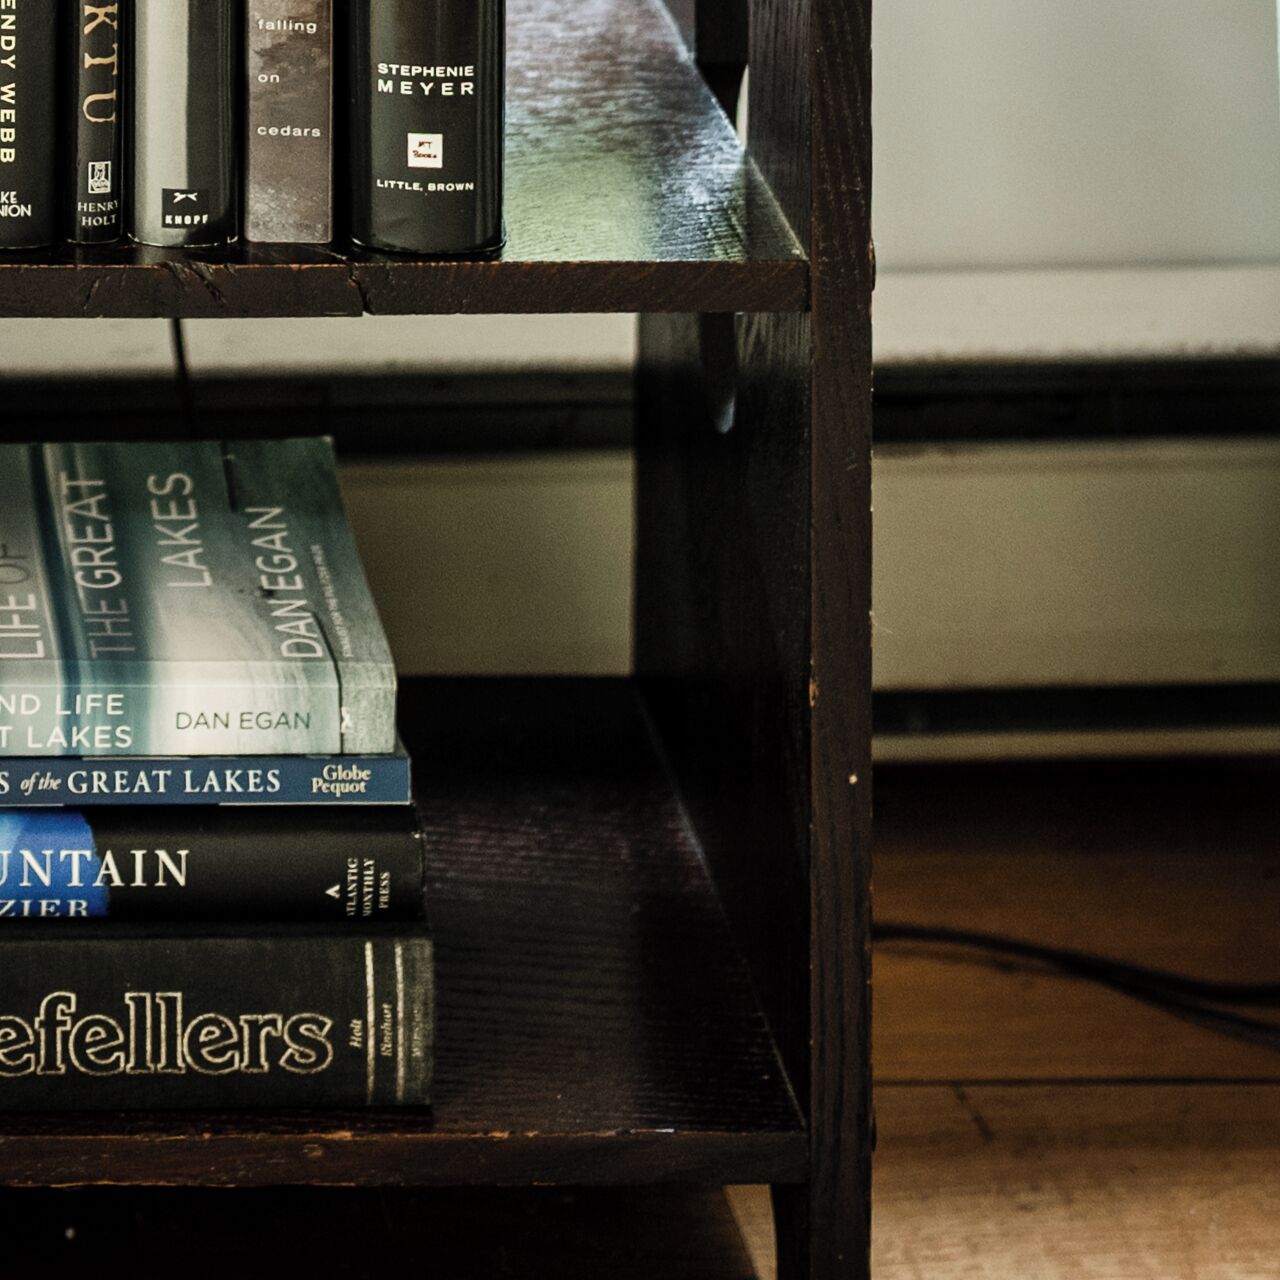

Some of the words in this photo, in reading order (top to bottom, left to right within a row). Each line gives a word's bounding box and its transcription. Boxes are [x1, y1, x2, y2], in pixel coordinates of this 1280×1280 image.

[257, 18, 318, 34] falling
[257, 72, 280, 84] on
[377, 62, 475, 78] STEPHENIE
[377, 79, 475, 96] MEYER
[0, 82, 17, 163] WEBB
[257, 124, 321, 138] cedars
[81, 213, 117, 227] HOLT
[164, 213, 209, 225] KNOPF
[59, 470, 123, 591] GREAT
[146, 470, 213, 588] LAKES
[245, 505, 303, 592] EGAN
[83, 597, 136, 659] THE
[266, 597, 324, 660] DAN
[55, 693, 125, 716] LIFE
[176, 711, 230, 730] DAN
[239, 711, 311, 730] EGAN
[26, 724, 133, 748] LAKES
[322, 763, 371, 782] Globe
[311, 776, 367, 798] Pequot
[378, 871, 391, 909] PRESS
